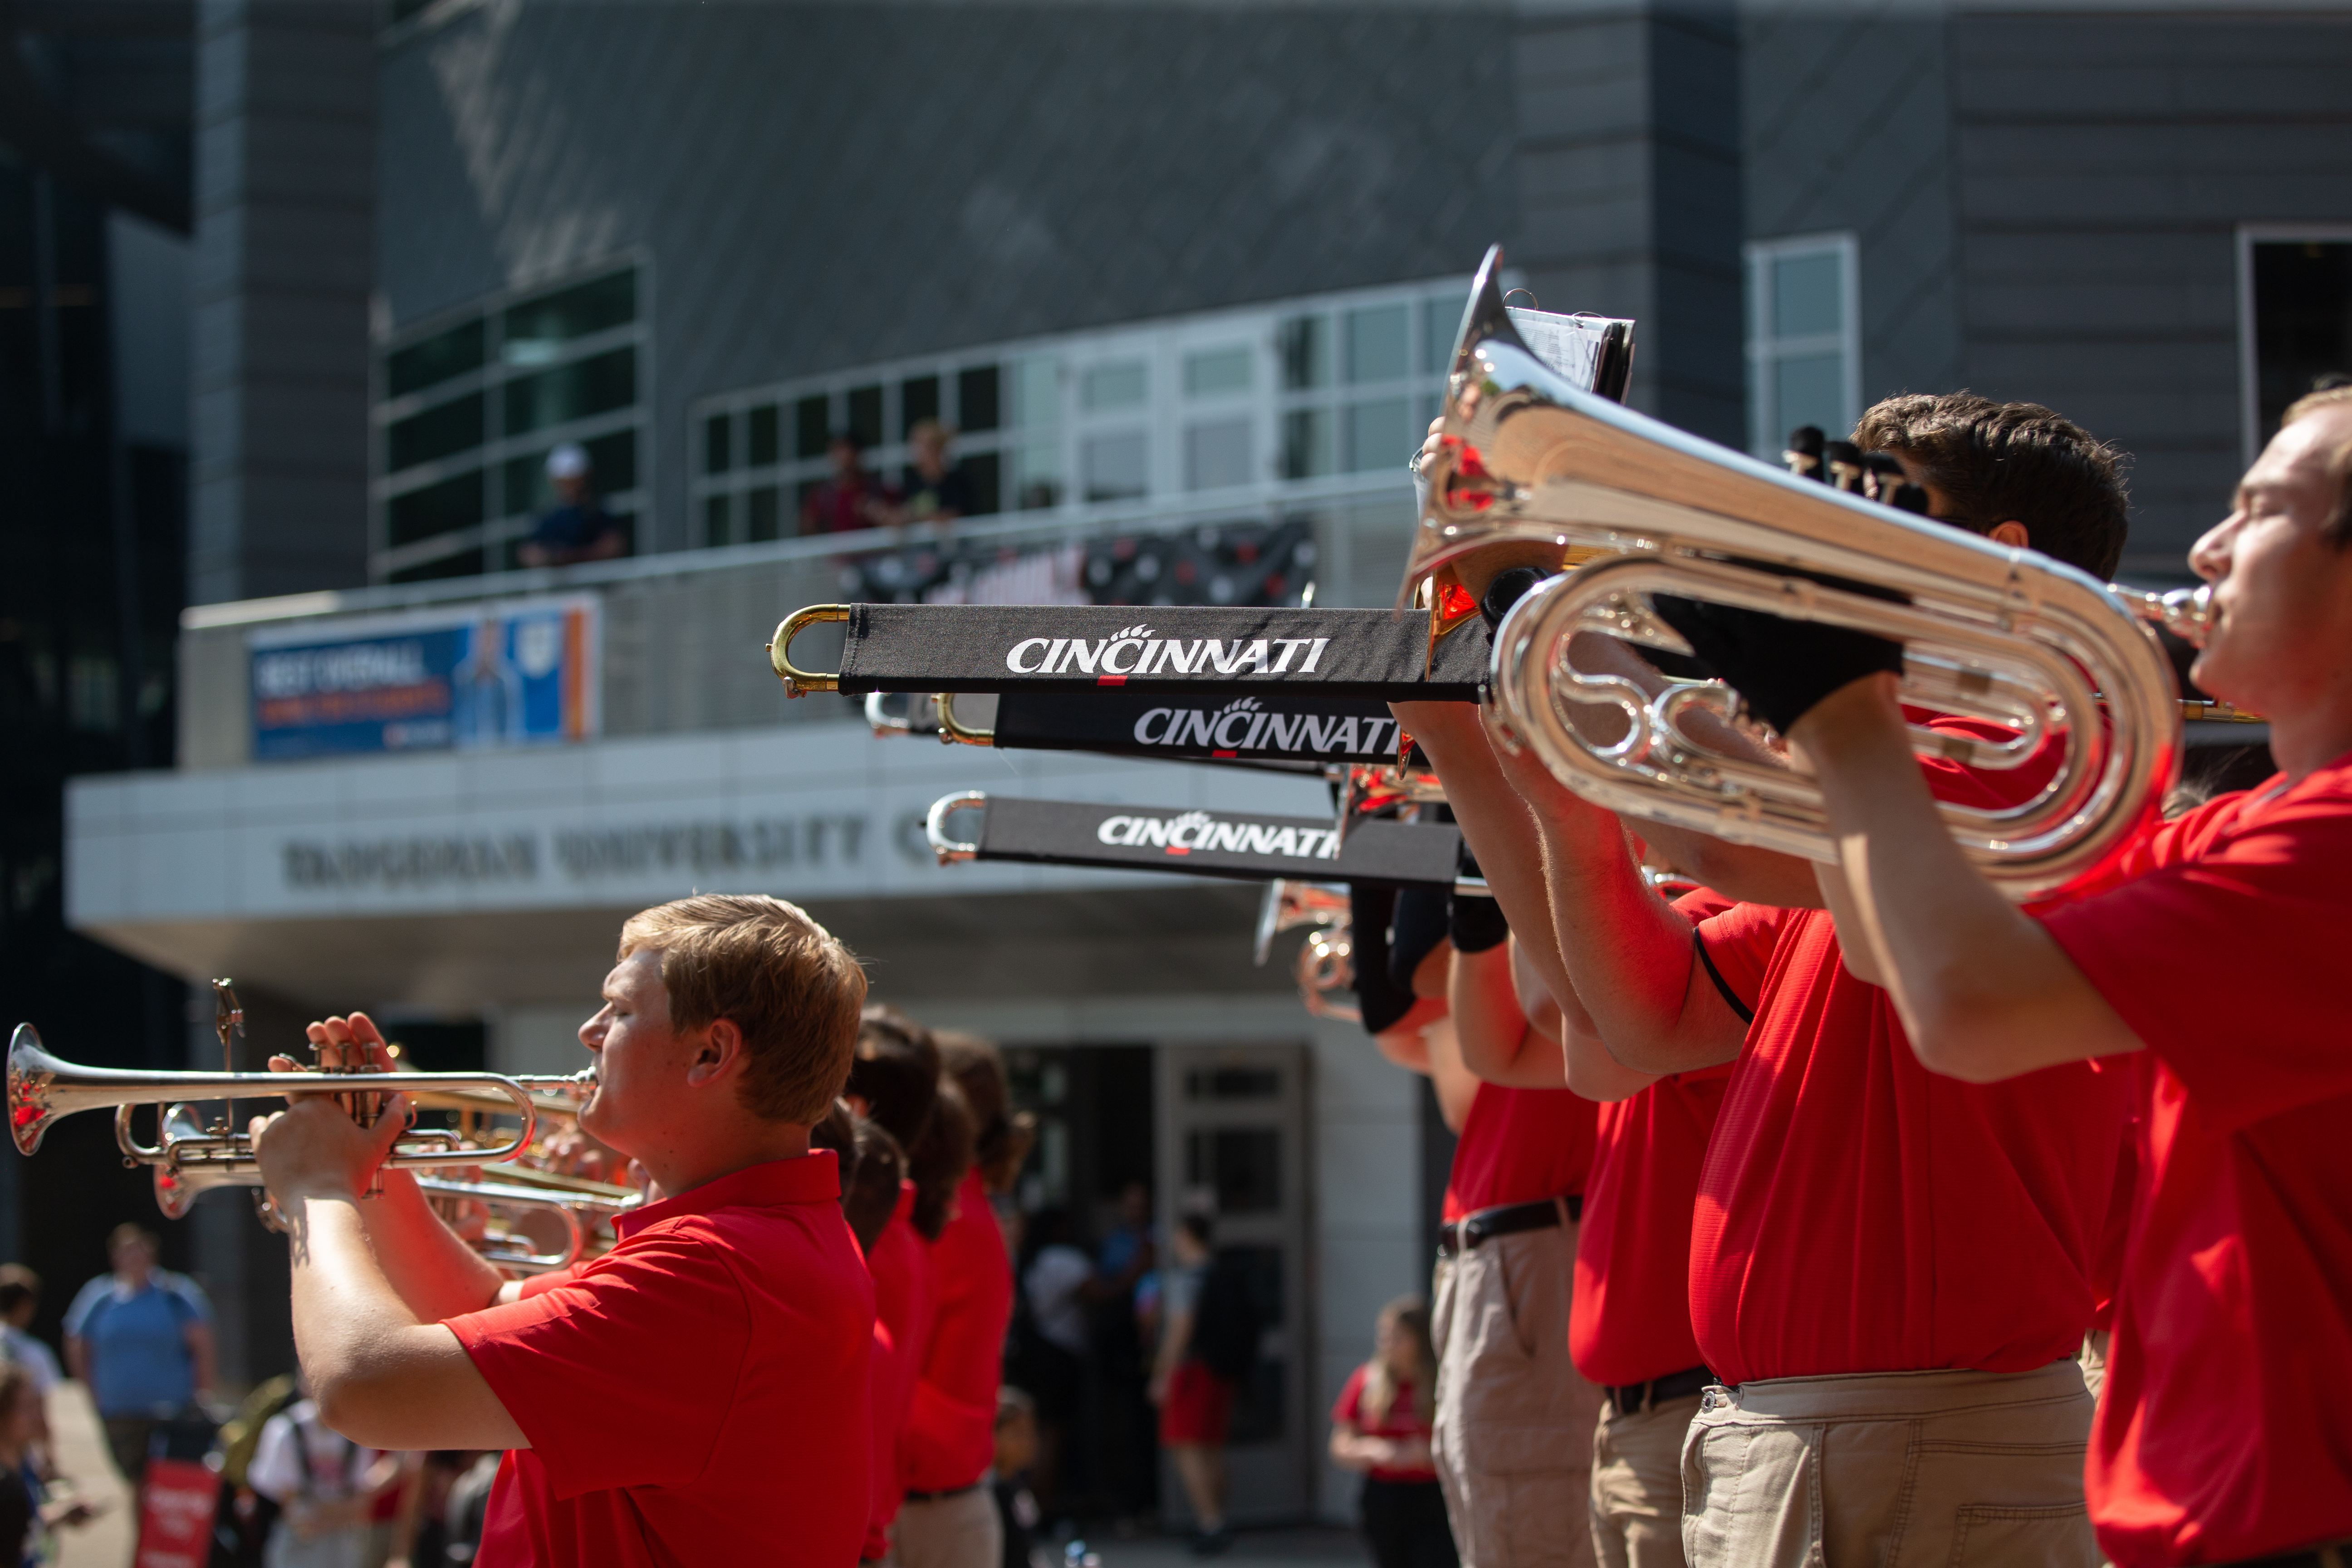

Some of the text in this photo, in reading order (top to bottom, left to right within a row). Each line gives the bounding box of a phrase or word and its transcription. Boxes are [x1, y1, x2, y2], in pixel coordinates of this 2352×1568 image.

[1006, 637, 1330, 674] CINCINNATI
[1133, 707, 1402, 755] CINCINNATI
[1097, 815, 1339, 860] CINCINNATI
